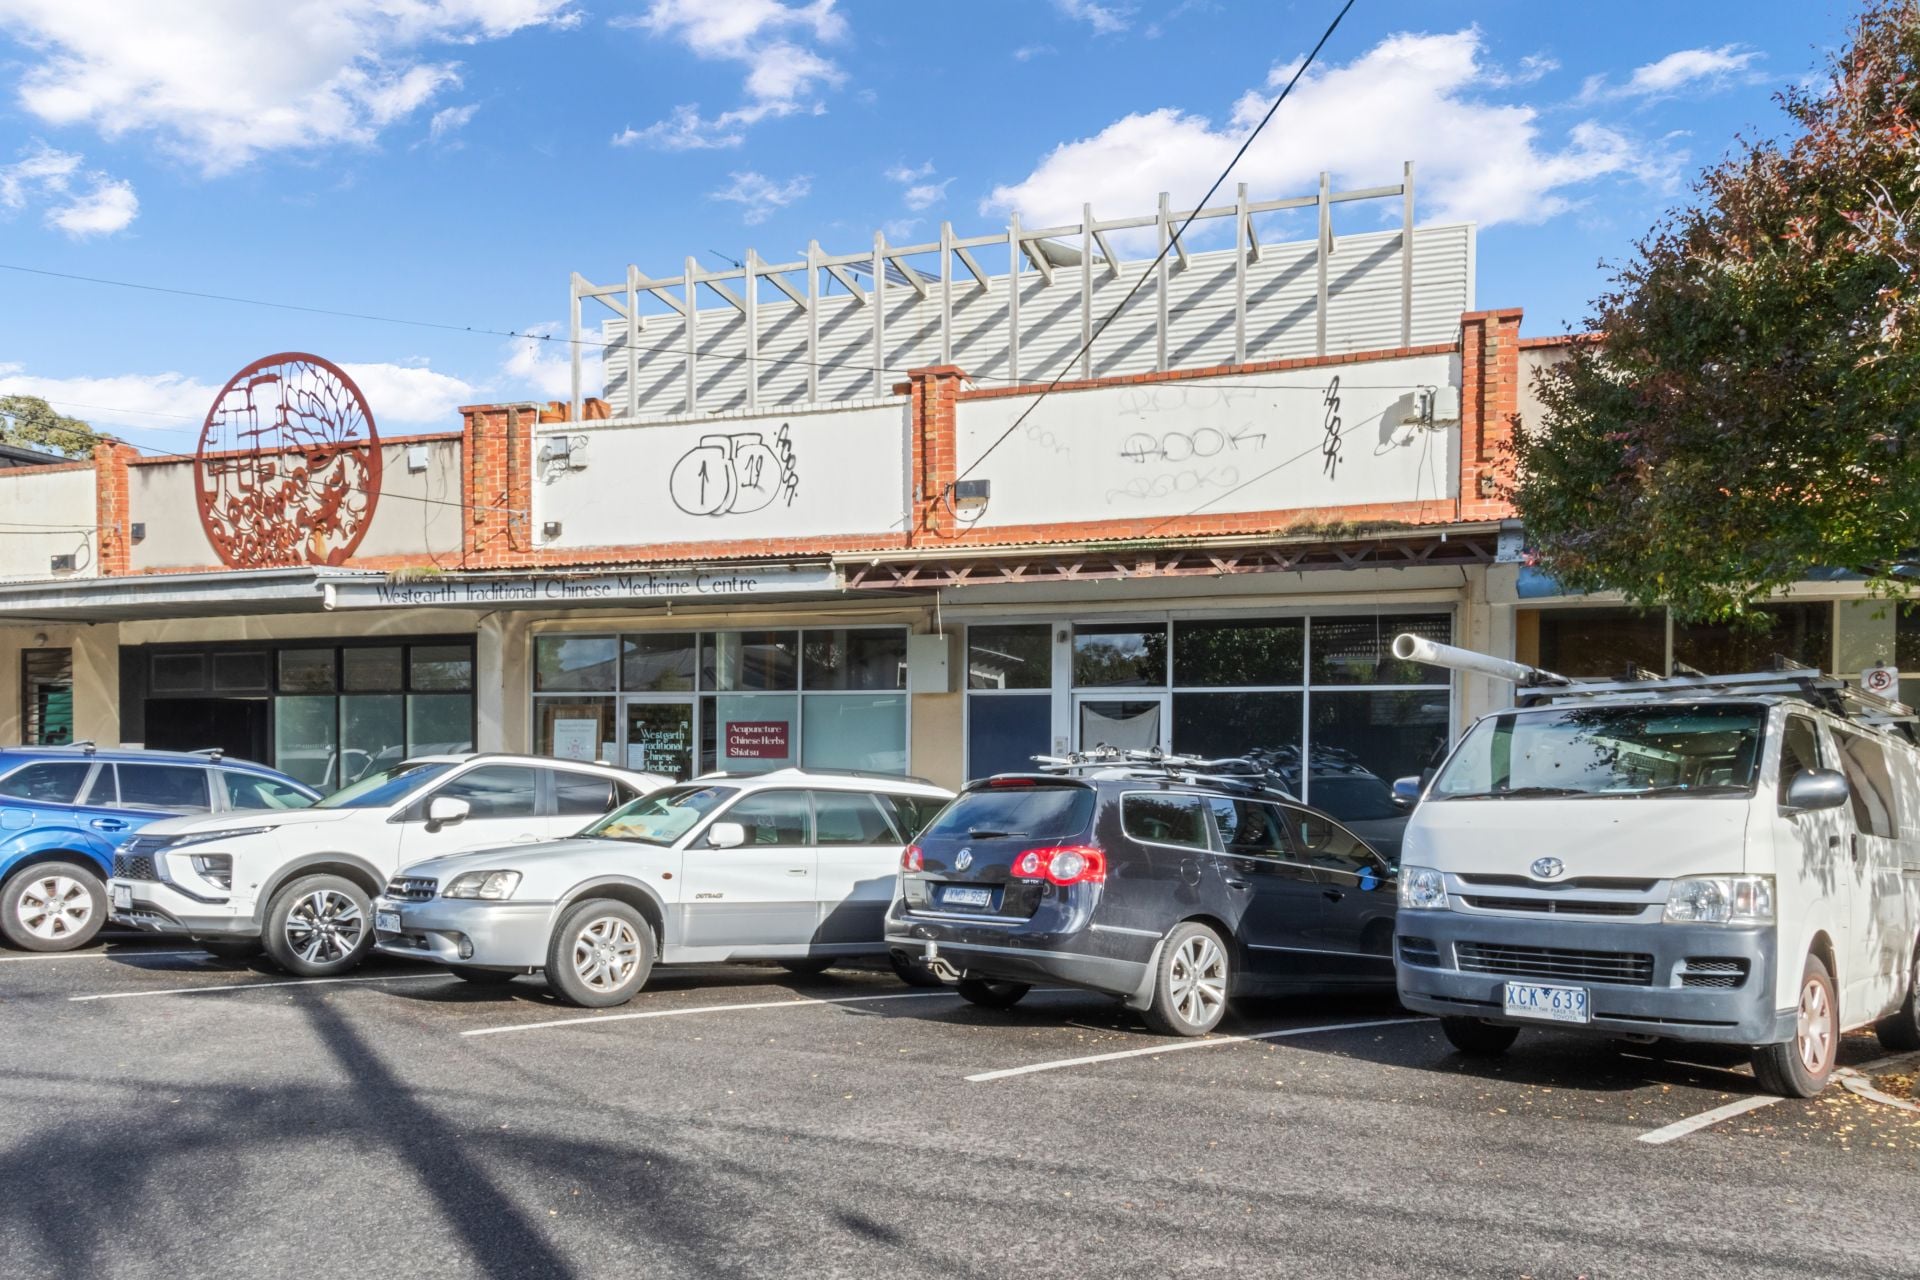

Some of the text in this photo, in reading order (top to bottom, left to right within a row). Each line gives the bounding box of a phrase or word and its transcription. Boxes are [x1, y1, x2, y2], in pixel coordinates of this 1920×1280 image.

[376, 574, 757, 605] Westgarth Traditional Chinese Medicine Centre
[640, 725, 685, 744] Westgarth
[731, 724, 782, 736] Acupuncture
[640, 739, 683, 751] Traditional
[730, 736, 785, 745] Chinese Herbs
[730, 747, 759, 757] Shiatsu
[1507, 986, 1585, 1010] XCK 639
